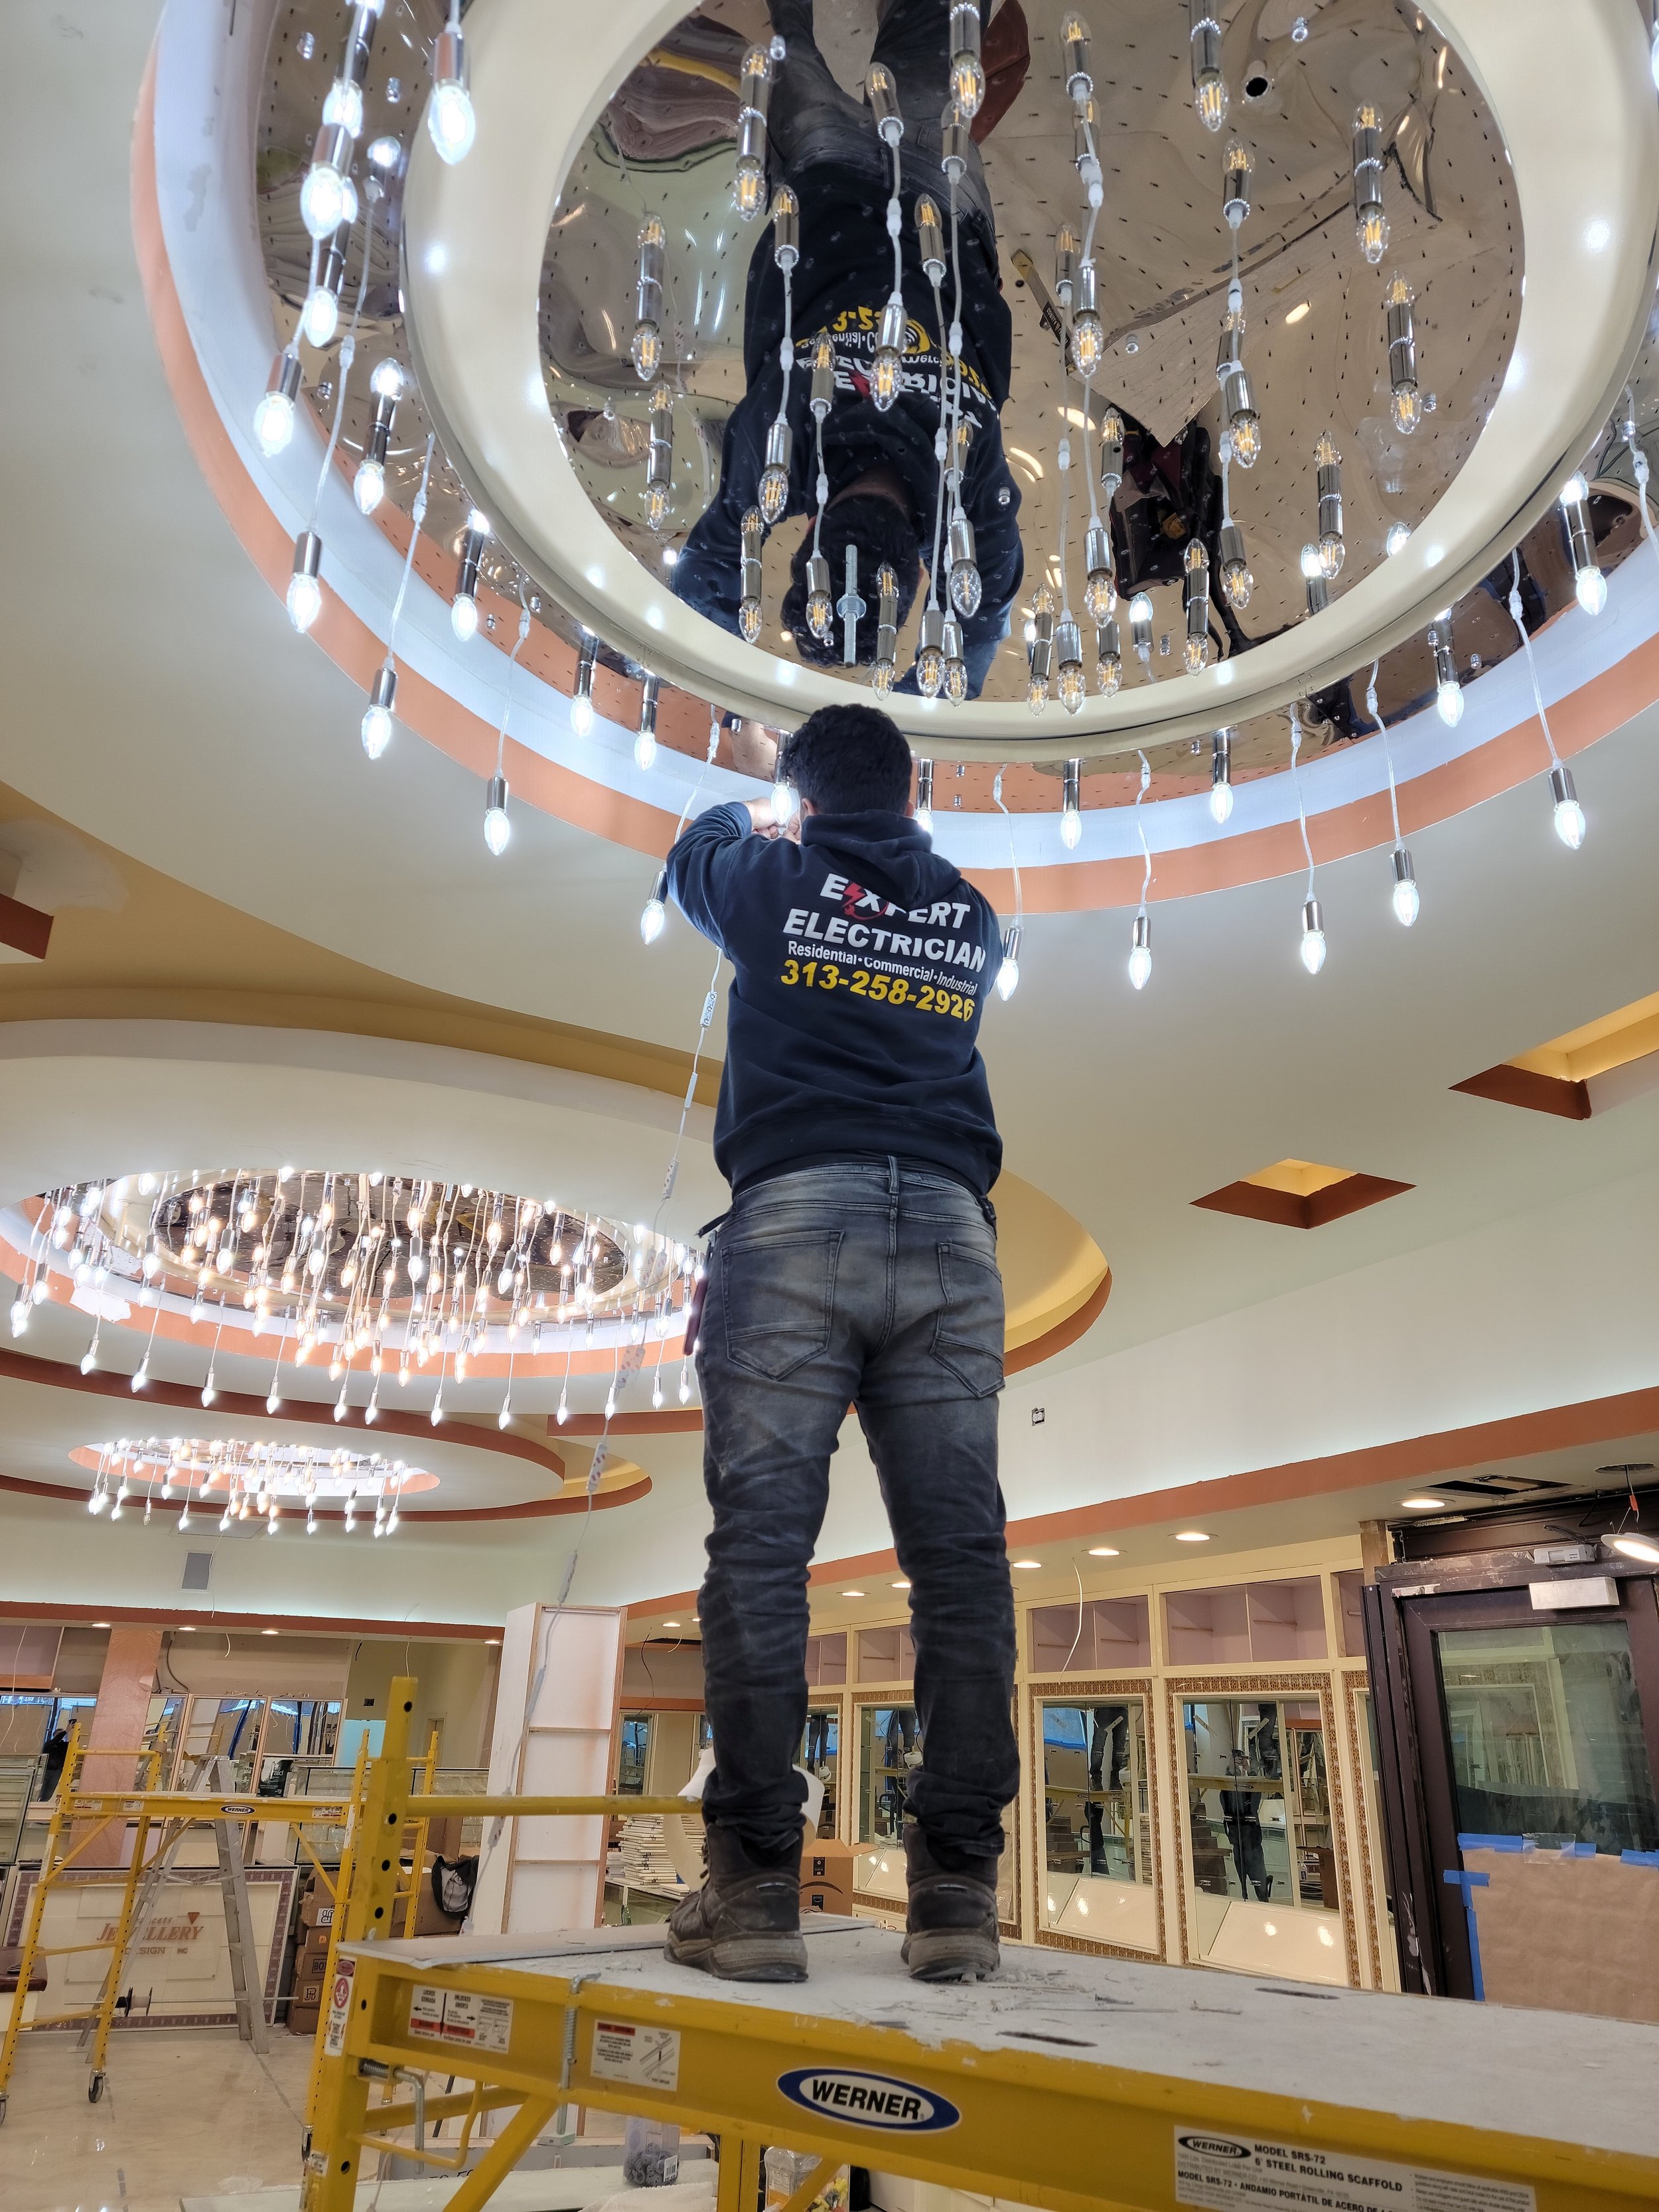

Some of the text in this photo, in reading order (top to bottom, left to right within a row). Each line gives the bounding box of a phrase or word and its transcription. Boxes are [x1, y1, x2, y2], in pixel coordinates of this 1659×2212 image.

[783, 908, 986, 973] ELECTRICIAN
[780, 959, 975, 1022] 313-258-2926
[96, 1923, 205, 1941] JELLERY
[125, 1947, 166, 1955] DSIGN
[812, 2079, 922, 2120] WERNER
[1192, 2140, 1237, 2154] WERNER
[1254, 2144, 1326, 2165] MODEL SRS-72
[1178, 2171, 1204, 2183] MODEL
[1206, 2176, 1232, 2188] SRS-72
[1240, 2182, 1277, 2197] ANDAMIO
[1279, 2188, 1319, 2205] PORTÁTIL
[1322, 2198, 1333, 2207] DE
[1336, 2201, 1364, 2212] ACERO
[1266, 2160, 1297, 2173] STEEL
[1300, 2165, 1344, 2181] ROLLING
[1348, 2174, 1403, 2192] SCAFFOLD
